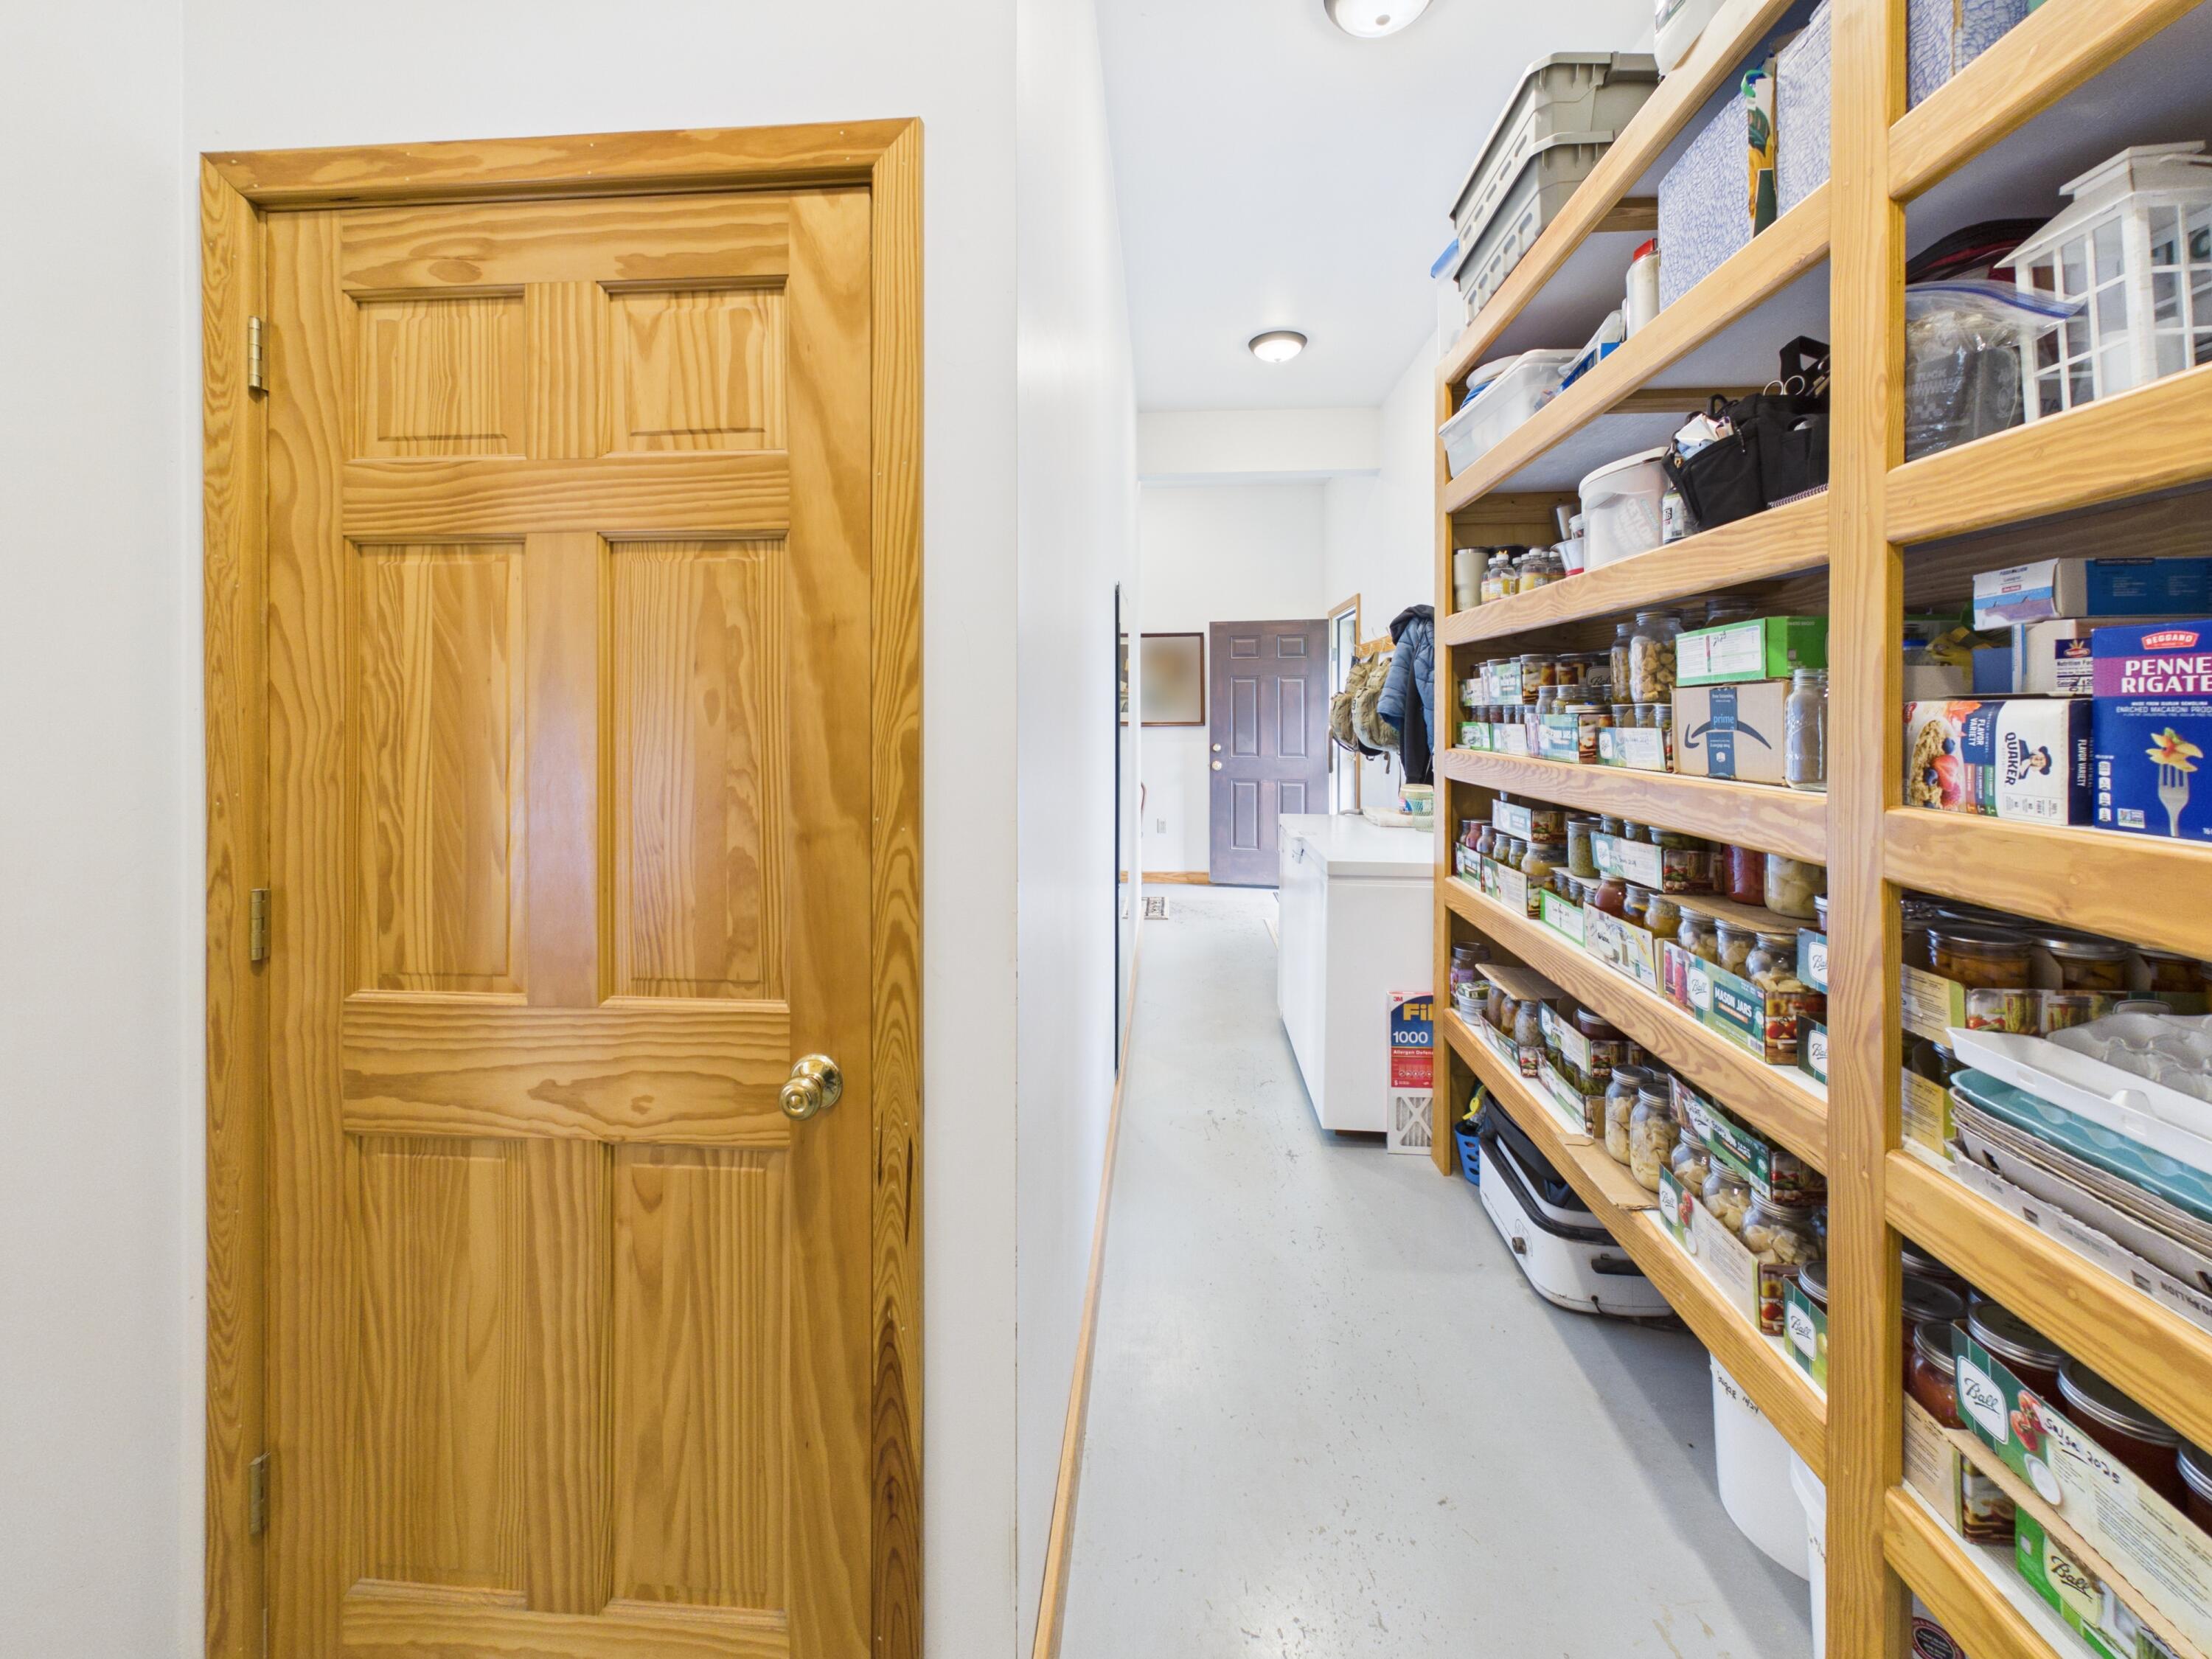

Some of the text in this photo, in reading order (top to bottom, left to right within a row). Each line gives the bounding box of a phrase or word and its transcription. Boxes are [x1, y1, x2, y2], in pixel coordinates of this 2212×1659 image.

[2125, 656, 2212, 676] PENNE
[2121, 675, 2212, 693] RIGATE
[1714, 714, 1734, 726] prime
[1969, 717, 1978, 746] VARIETY
[1976, 718, 1986, 745] FLAVOR
[2004, 731, 2020, 786] QUAKER
[2077, 739, 2087, 787] FLAVOR VARIETY
[1691, 979, 1708, 995] Ball
[1714, 987, 1736, 1009] MASON
[1736, 999, 1752, 1018] JARS
[1392, 1031, 1428, 1044] 1000
[1661, 1191, 1675, 1208] Ball
[1791, 1315, 1812, 1340] Ball
[1964, 1377, 1999, 1411] Ball
[2087, 1450, 2121, 1484] 2025
[2051, 1555, 2091, 1596] Ball
